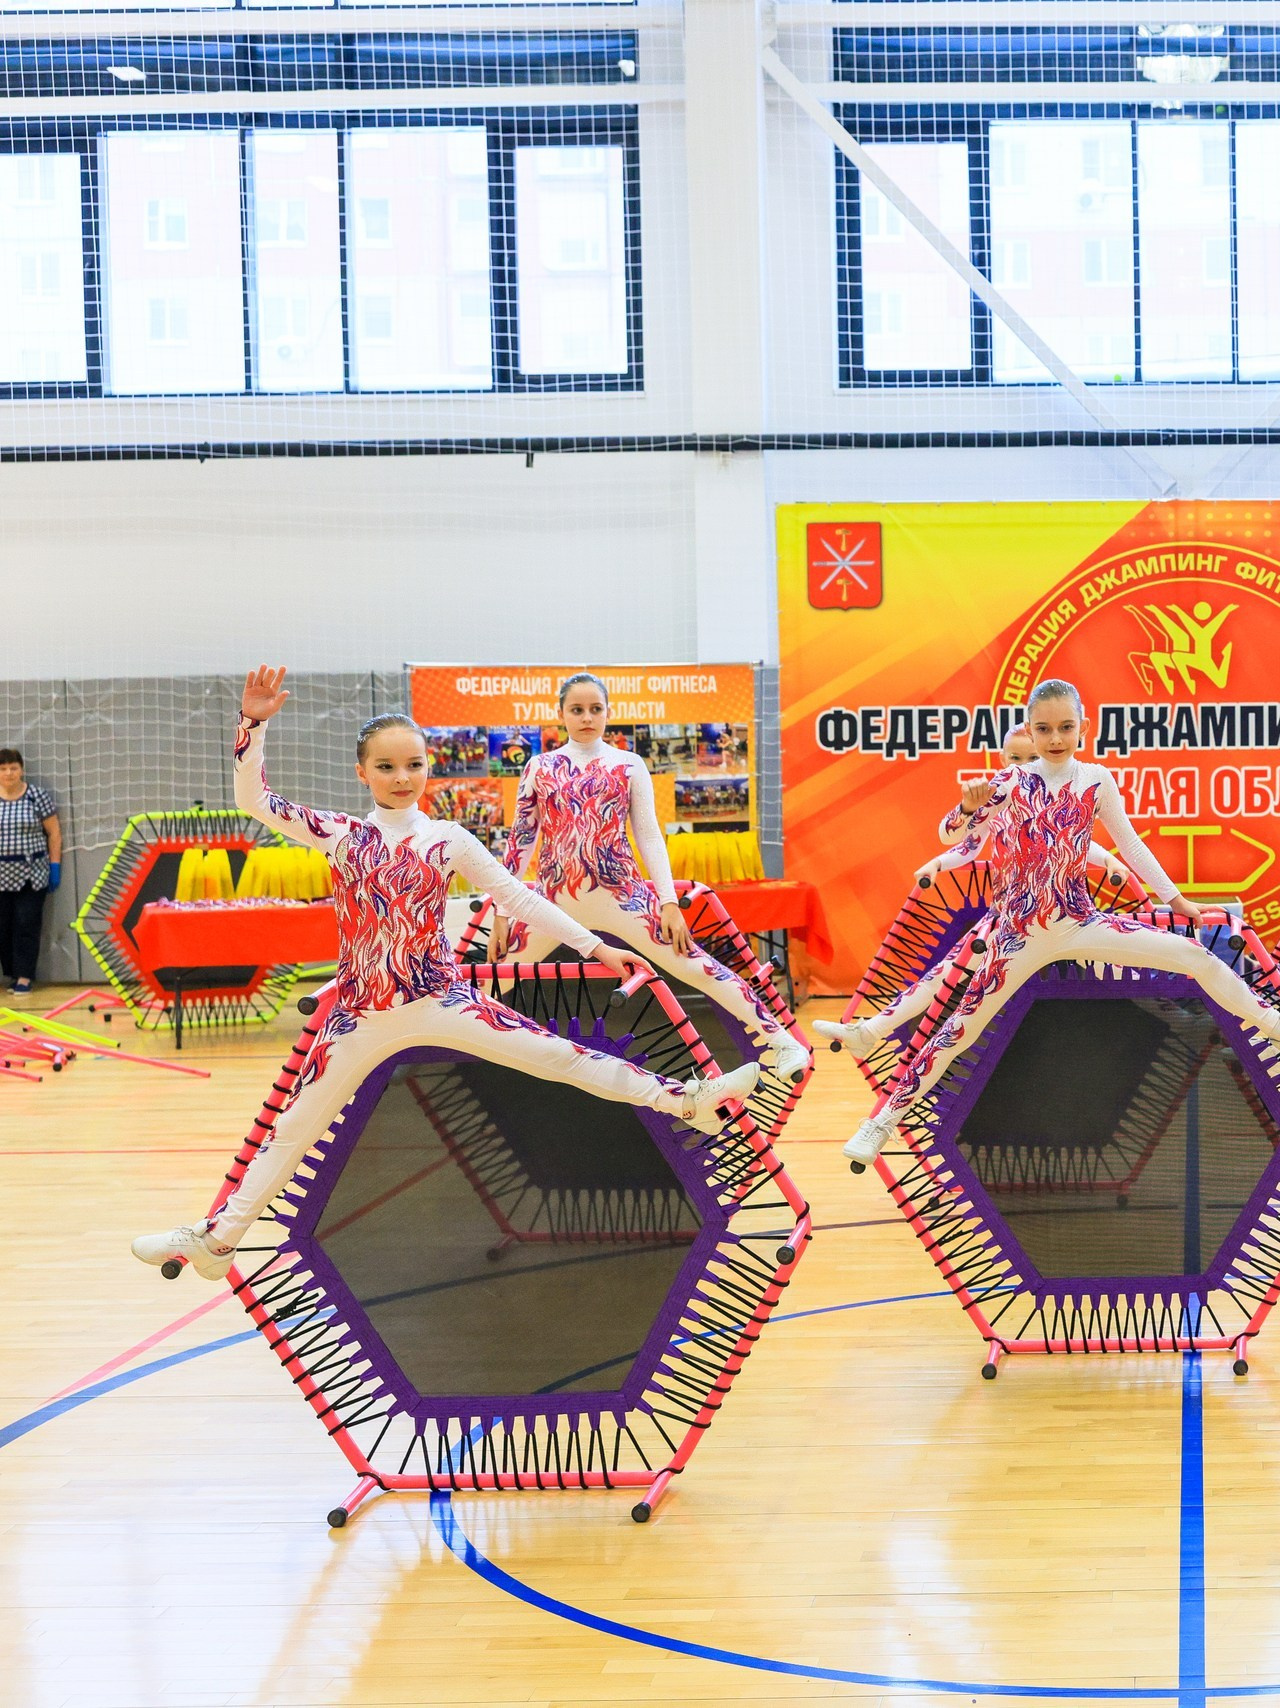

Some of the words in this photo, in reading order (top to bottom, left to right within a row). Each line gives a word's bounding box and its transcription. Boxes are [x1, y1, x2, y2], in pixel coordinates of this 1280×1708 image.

[1003, 598, 1077, 705] ДЕРАЦИЯ
[1079, 552, 1227, 607] ДЖАМПИНГ
[456, 676, 551, 697] ФЕДЕРАЦИЯ
[648, 674, 717, 693] ФИТНЕСА
[607, 701, 665, 720] БЛАСТИ
